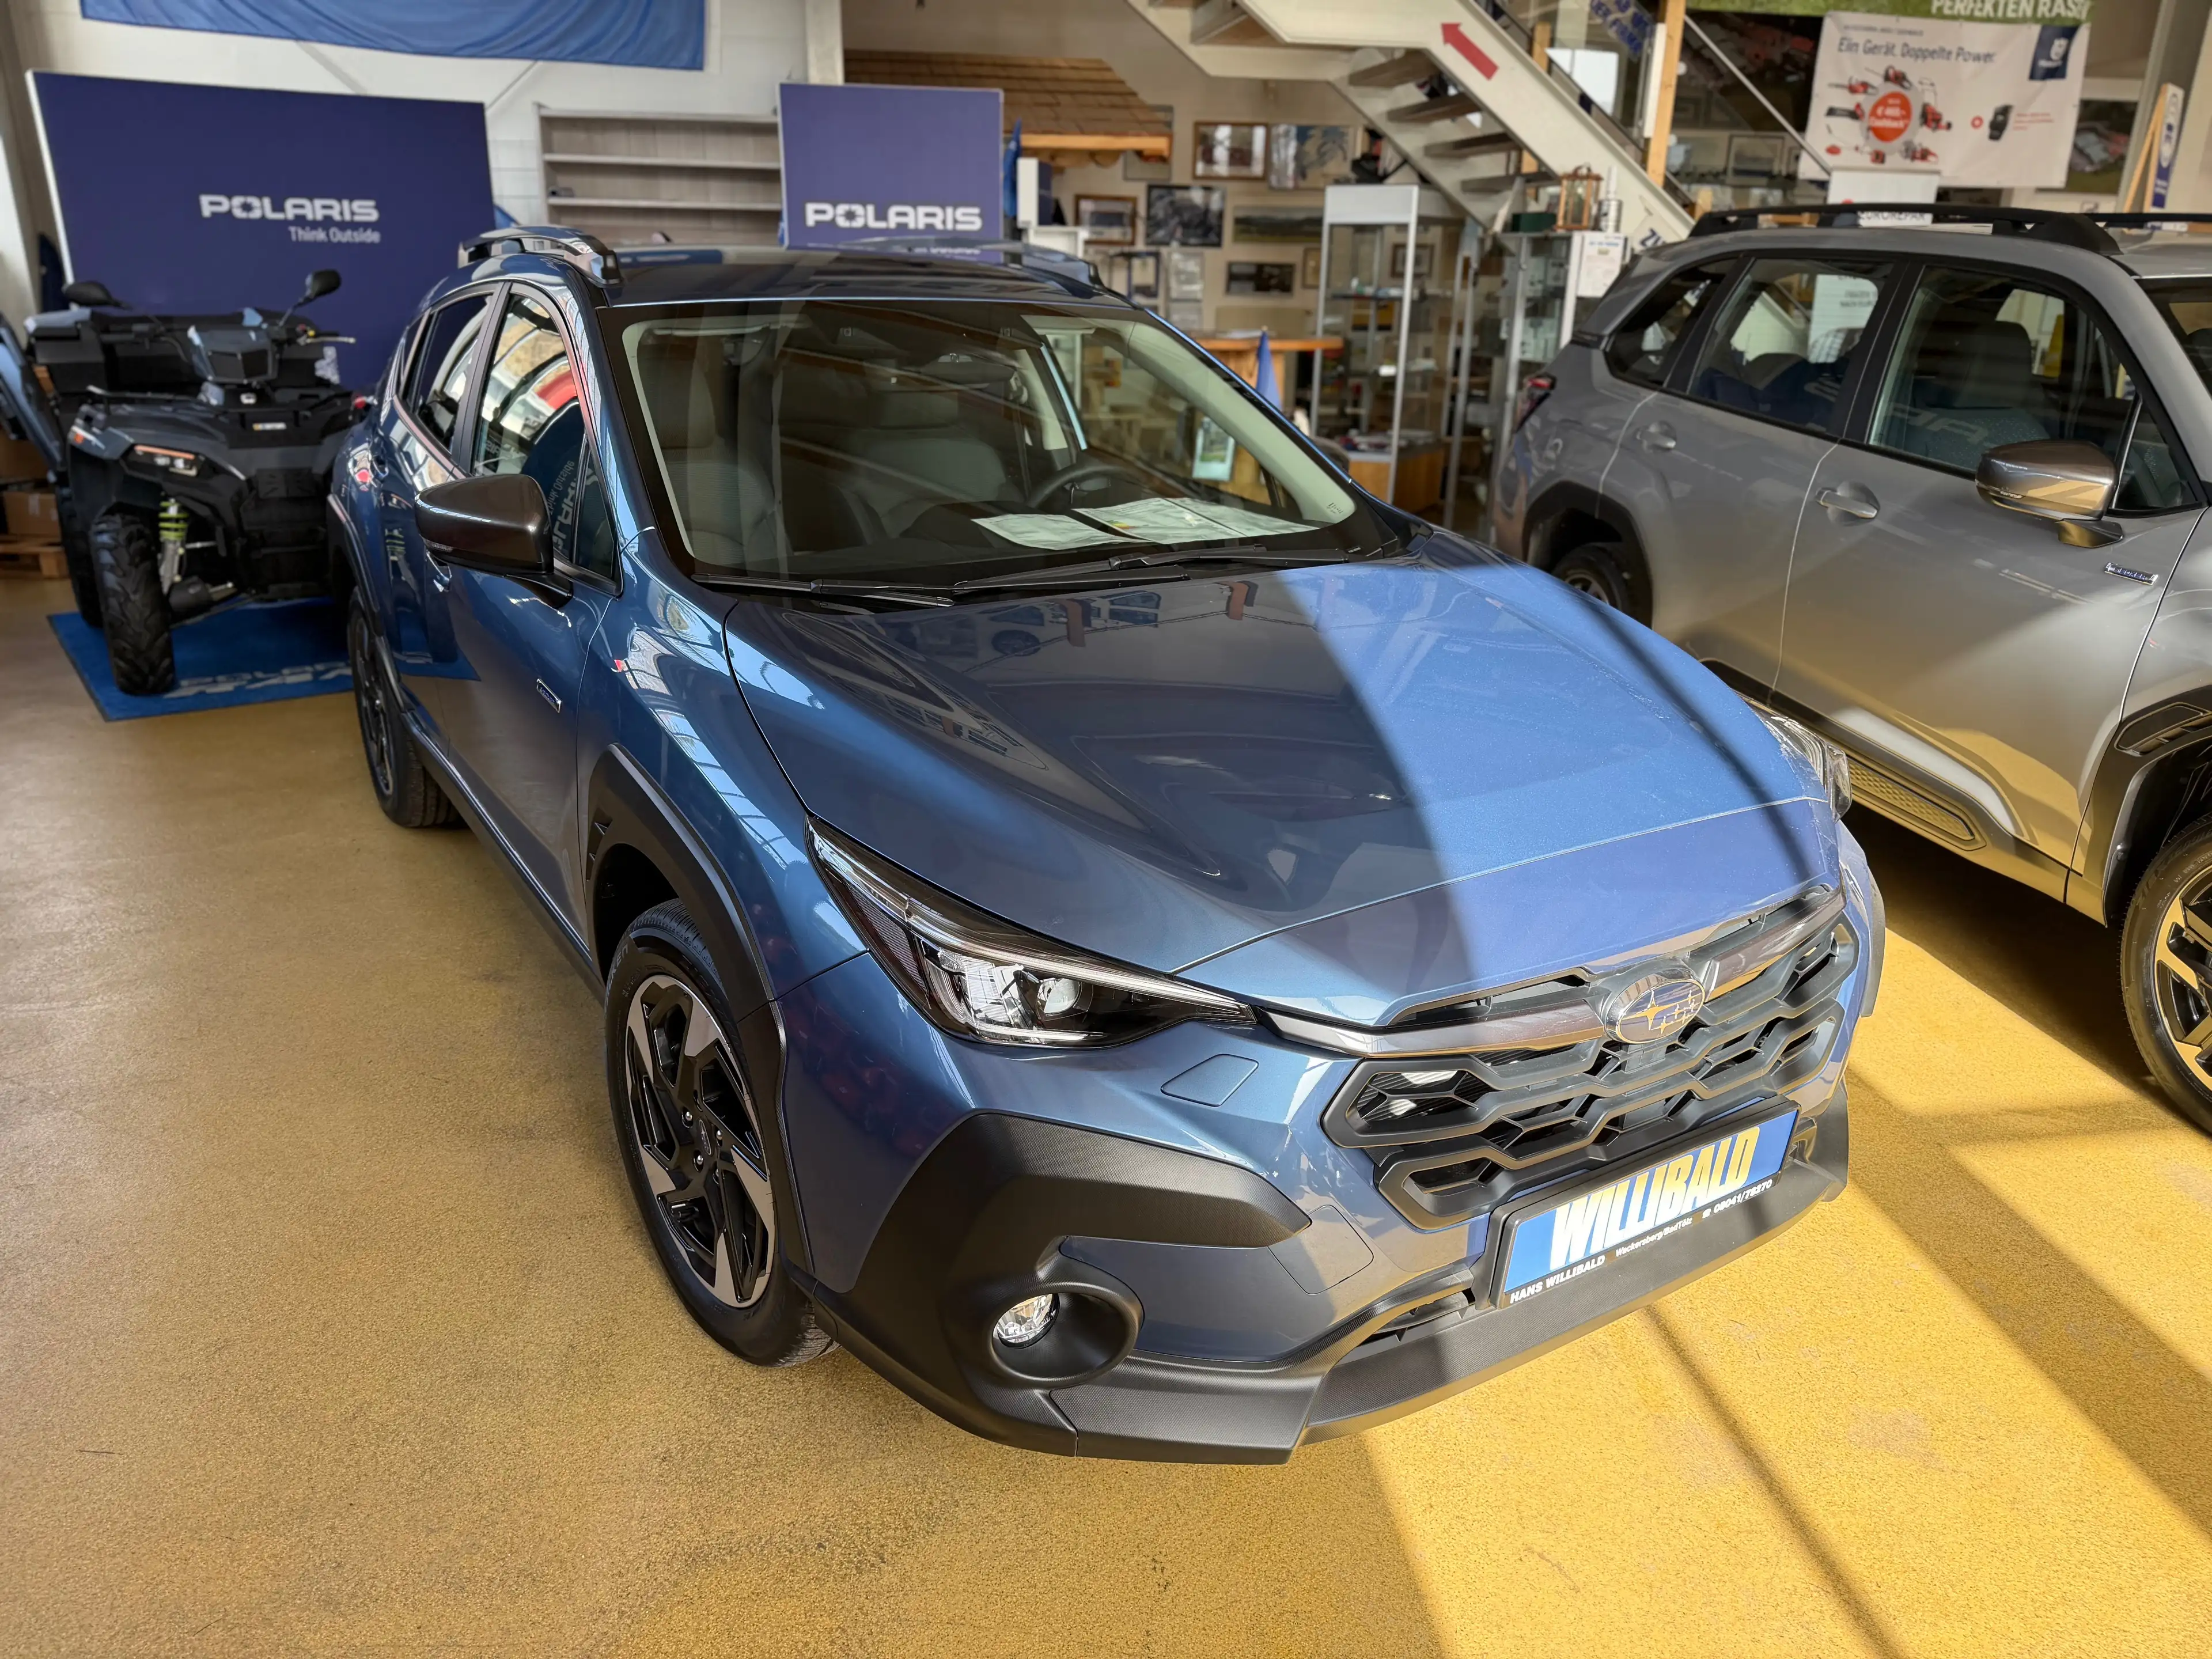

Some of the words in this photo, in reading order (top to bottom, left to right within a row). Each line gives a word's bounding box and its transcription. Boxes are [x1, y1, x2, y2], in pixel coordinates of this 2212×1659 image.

[1901, 42, 1952, 62] Doppelte
[199, 194, 379, 222] POLARIS
[805, 203, 982, 231] POLARIS
[288, 226, 328, 242] Think
[329, 227, 381, 244] Outside
[1550, 1126, 1760, 1271] WILLIBALD
[1510, 1281, 1543, 1304] HANS
[1546, 1255, 1605, 1289] WILLIBALD
